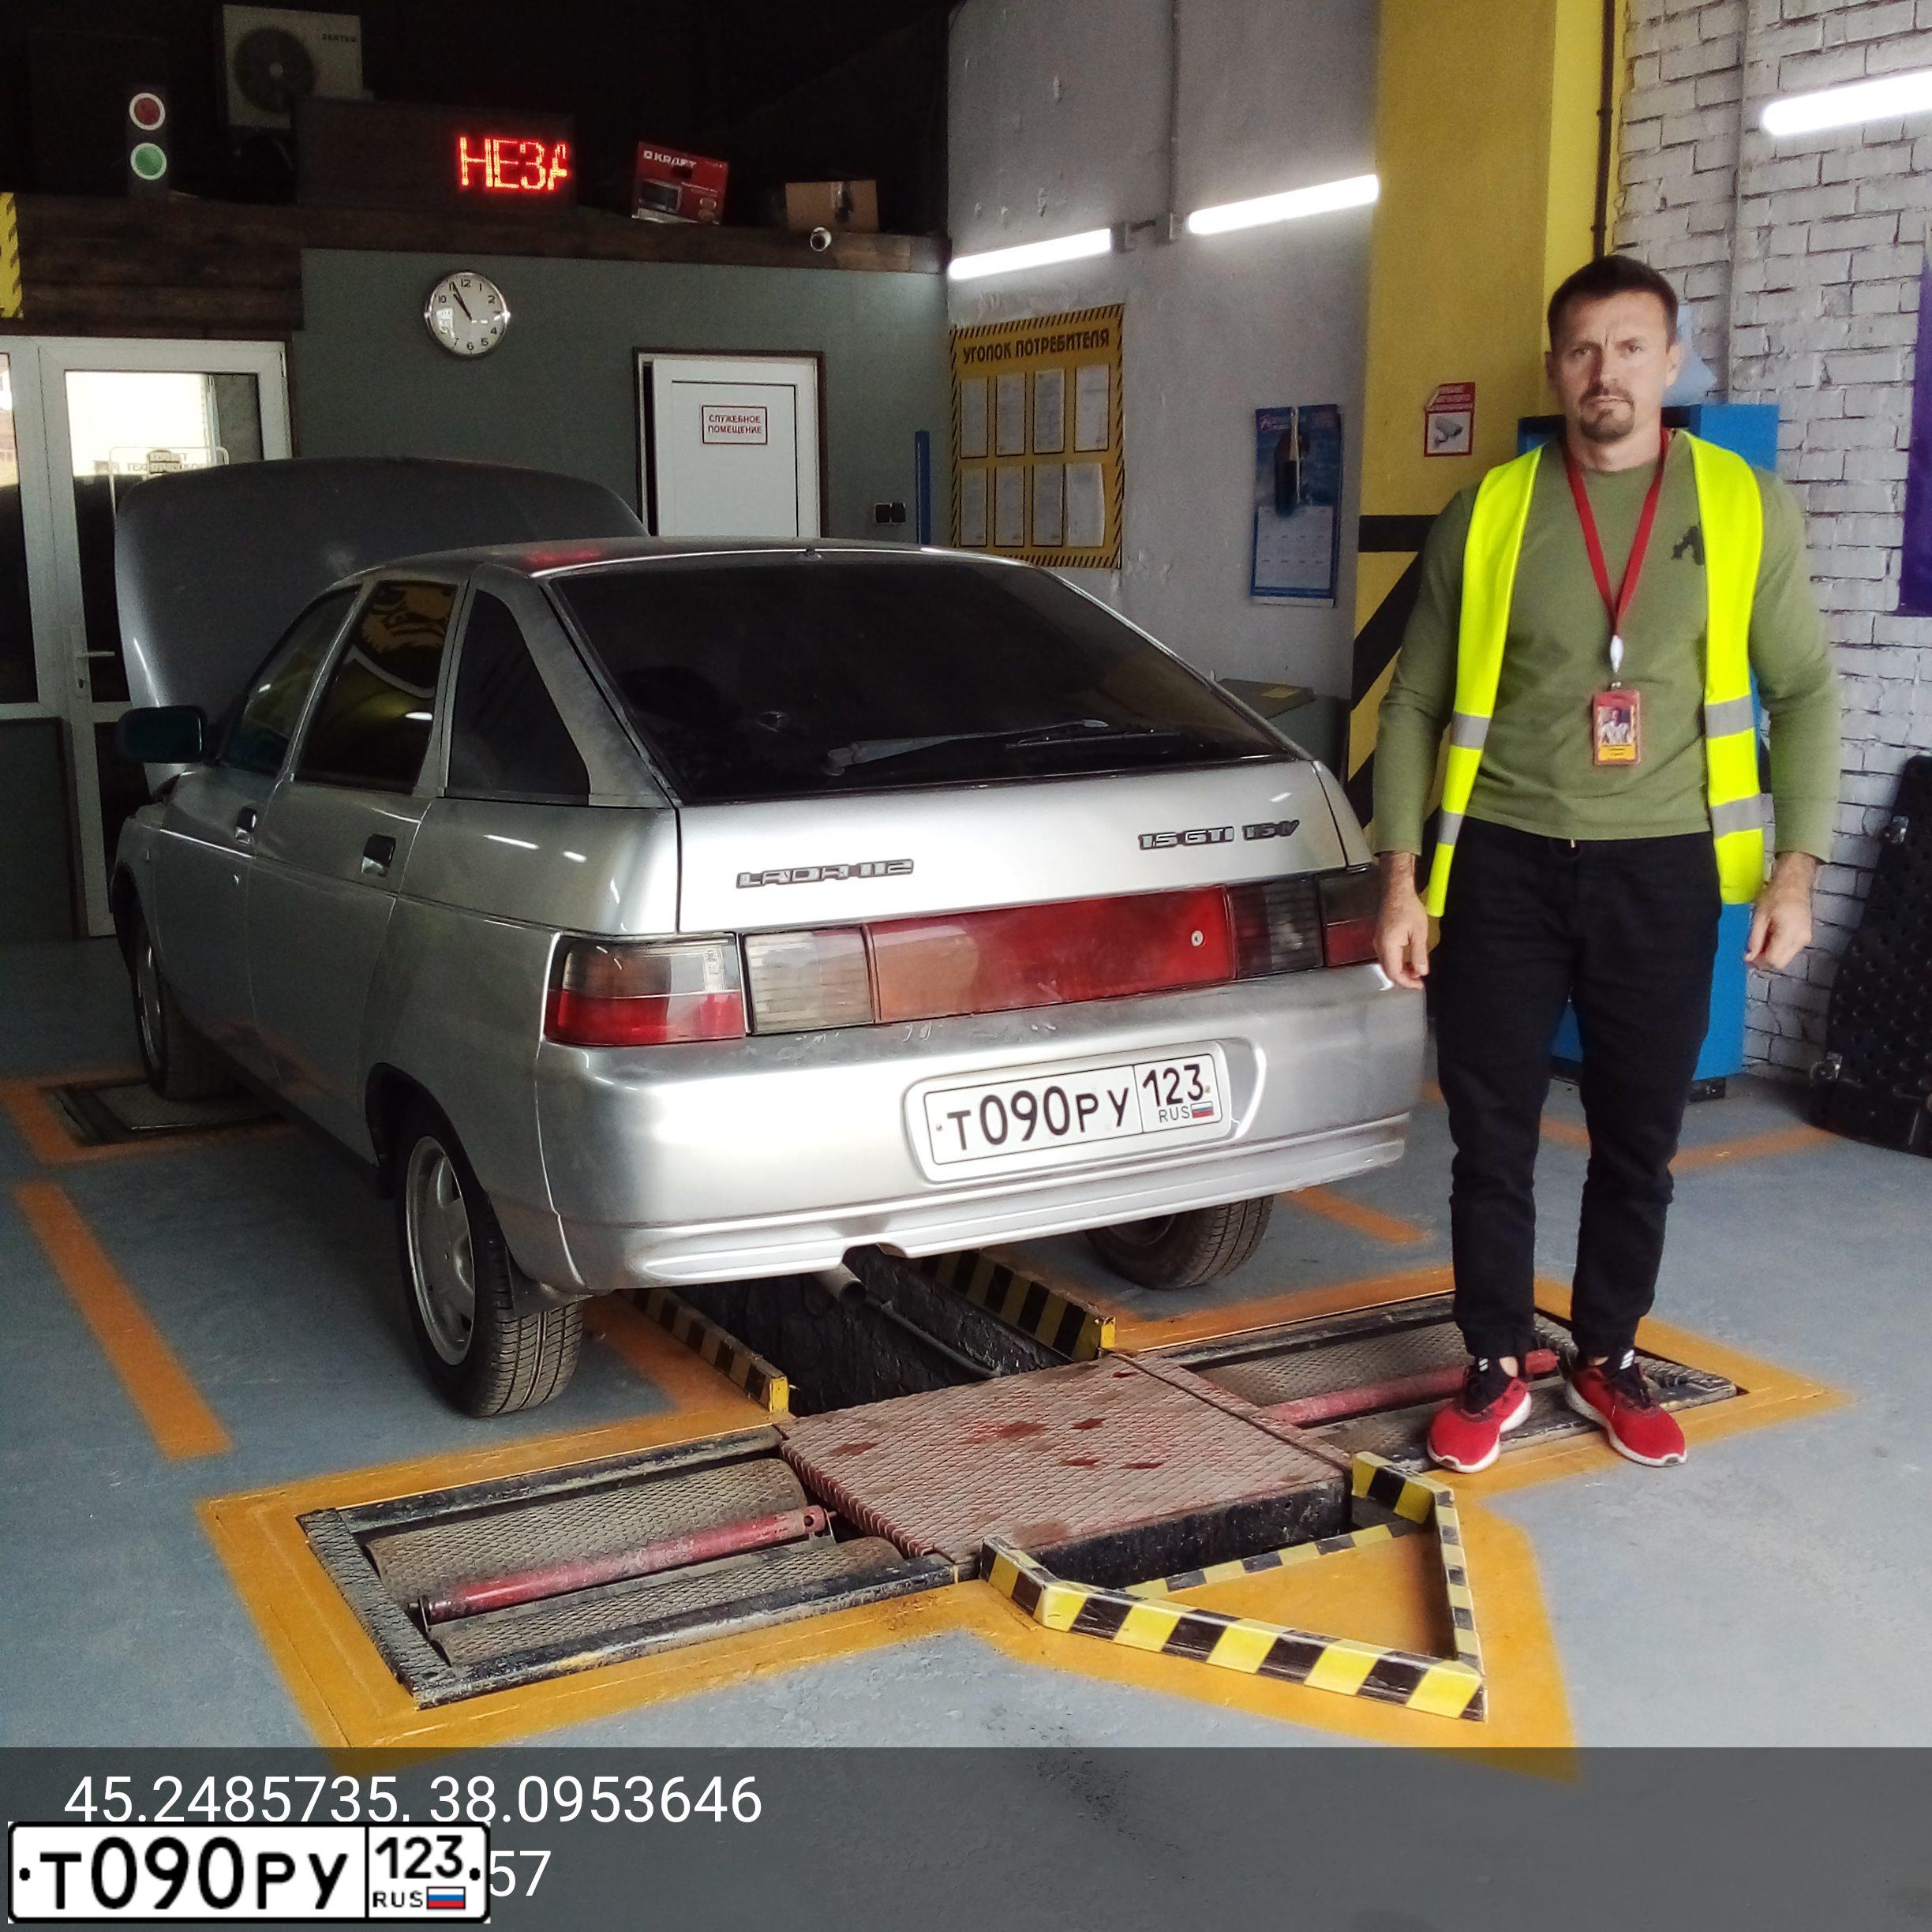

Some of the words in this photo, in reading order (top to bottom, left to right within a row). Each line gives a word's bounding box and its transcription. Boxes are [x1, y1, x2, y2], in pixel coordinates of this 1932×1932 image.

[461, 279, 471, 288] 12
[479, 283, 482, 292] 1
[439, 295, 447, 304] 10
[488, 295, 496, 304] 2
[490, 327, 498, 335] 4
[467, 342, 474, 350] 6
[481, 338, 489, 346] 5
[964, 341, 1011, 365] УГОЛОК
[1016, 328, 1110, 358] ПОТРЕБИТЕЛЯ
[709, 414, 761, 424] СЛУЖЕБНОЕ
[708, 425, 762, 435] ПОМЕЩЕНИЕ
[1184, 826, 1234, 846] GTI
[736, 863, 850, 889] LADA
[858, 859, 915, 878] 112
[947, 1086, 1129, 1151] Т090РУ
[1142, 1063, 1204, 1107] 123
[1159, 1105, 1190, 1123] RUS
